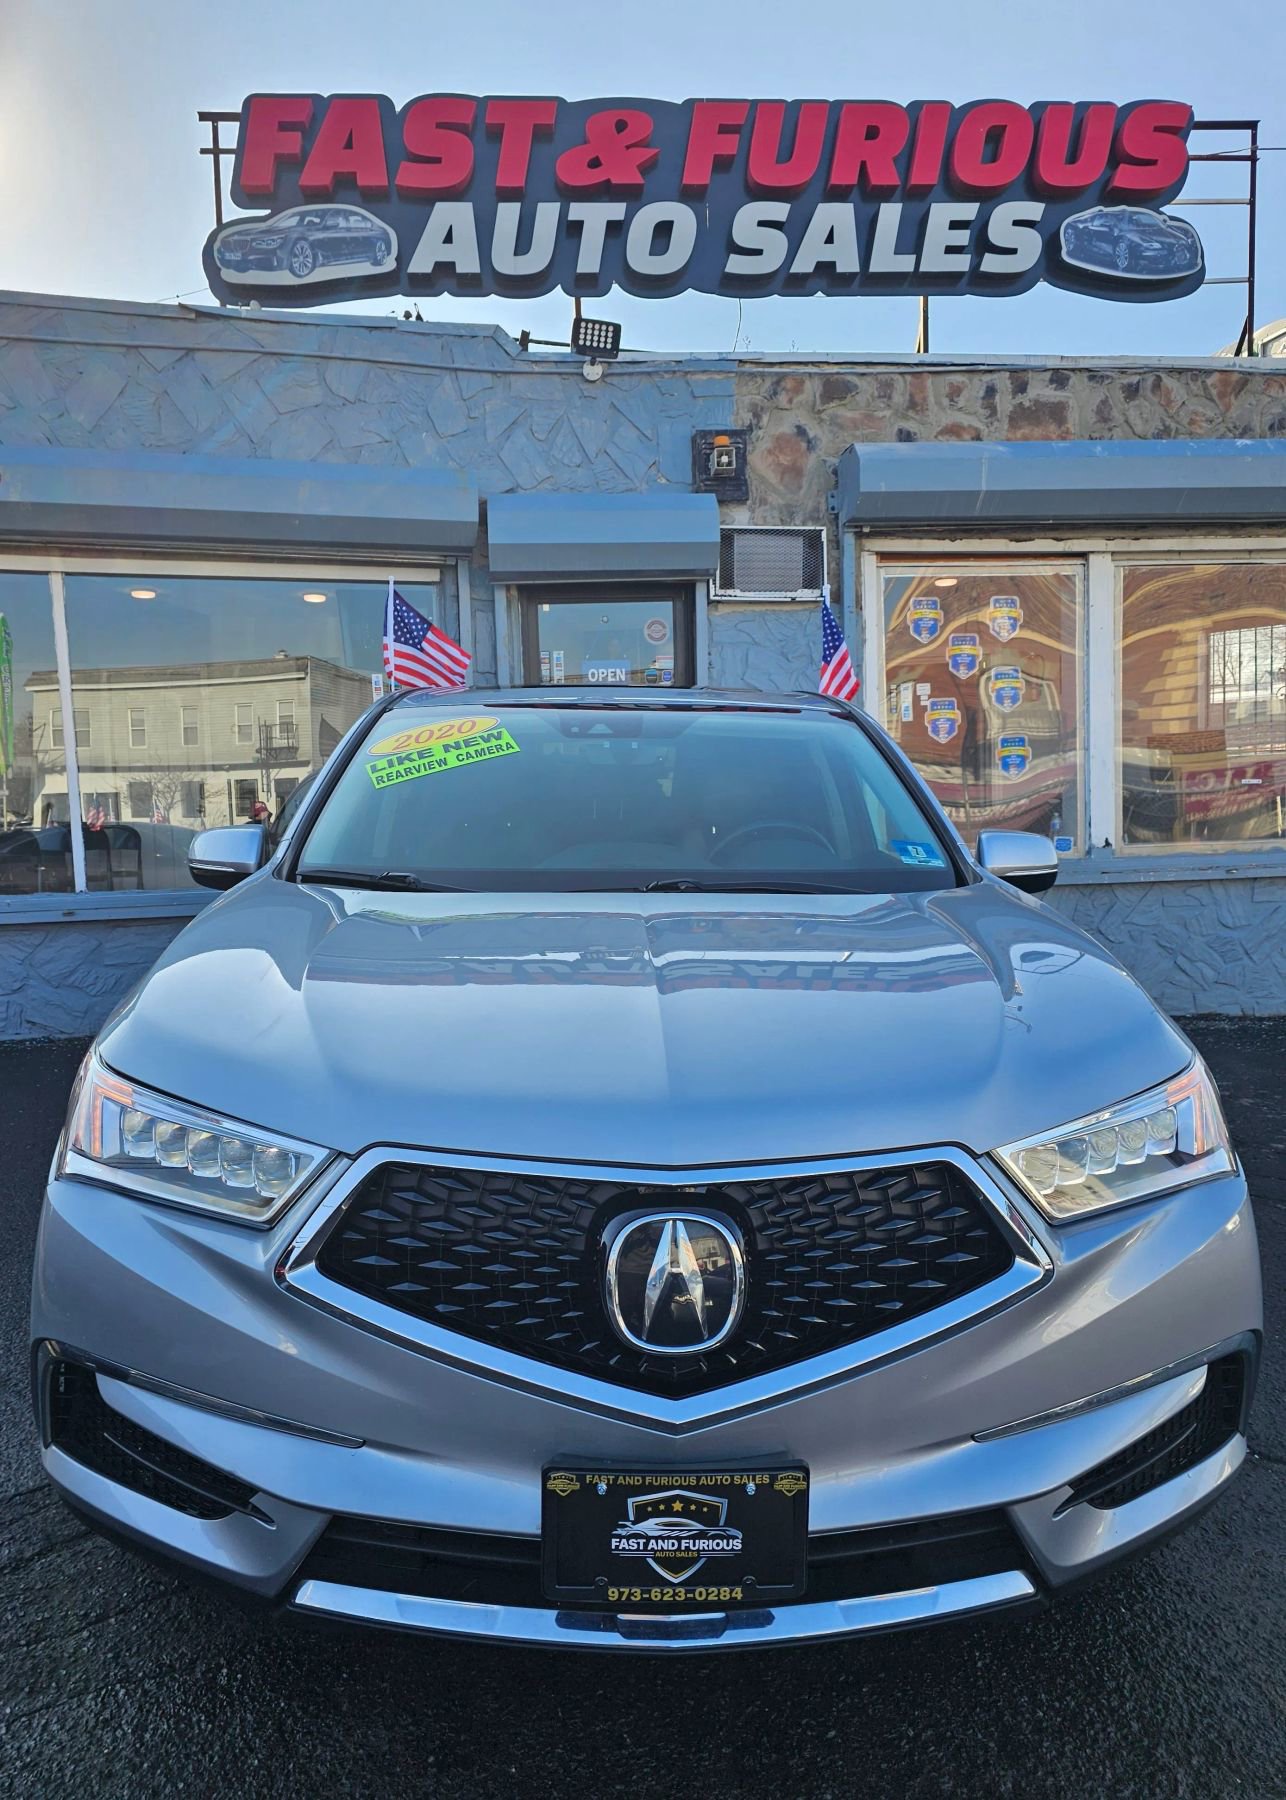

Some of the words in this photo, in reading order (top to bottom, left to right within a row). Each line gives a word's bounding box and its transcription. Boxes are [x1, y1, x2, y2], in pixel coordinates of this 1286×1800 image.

[240, 96, 557, 194] FAST
[556, 108, 661, 192] &
[682, 98, 1193, 194] FURIOUS
[407, 201, 697, 280] AUTO
[724, 201, 1046, 280] SALES
[588, 668, 626, 683] OPEN
[392, 719, 477, 751] 2020
[370, 747, 435, 775] LIKE
[443, 730, 504, 754] NEW
[375, 757, 449, 786] REARVIEW
[455, 741, 515, 763] CAMERA
[585, 1474, 616, 1485] FAST
[617, 1475, 642, 1486] AND
[645, 1475, 697, 1486] FURIOUS
[699, 1475, 732, 1486] AUTO
[733, 1474, 770, 1485] SALES
[611, 1538, 647, 1550] FAST
[648, 1539, 678, 1550] AND
[681, 1538, 743, 1550] FURIOUS
[607, 1587, 743, 1601] 973-623-0284
